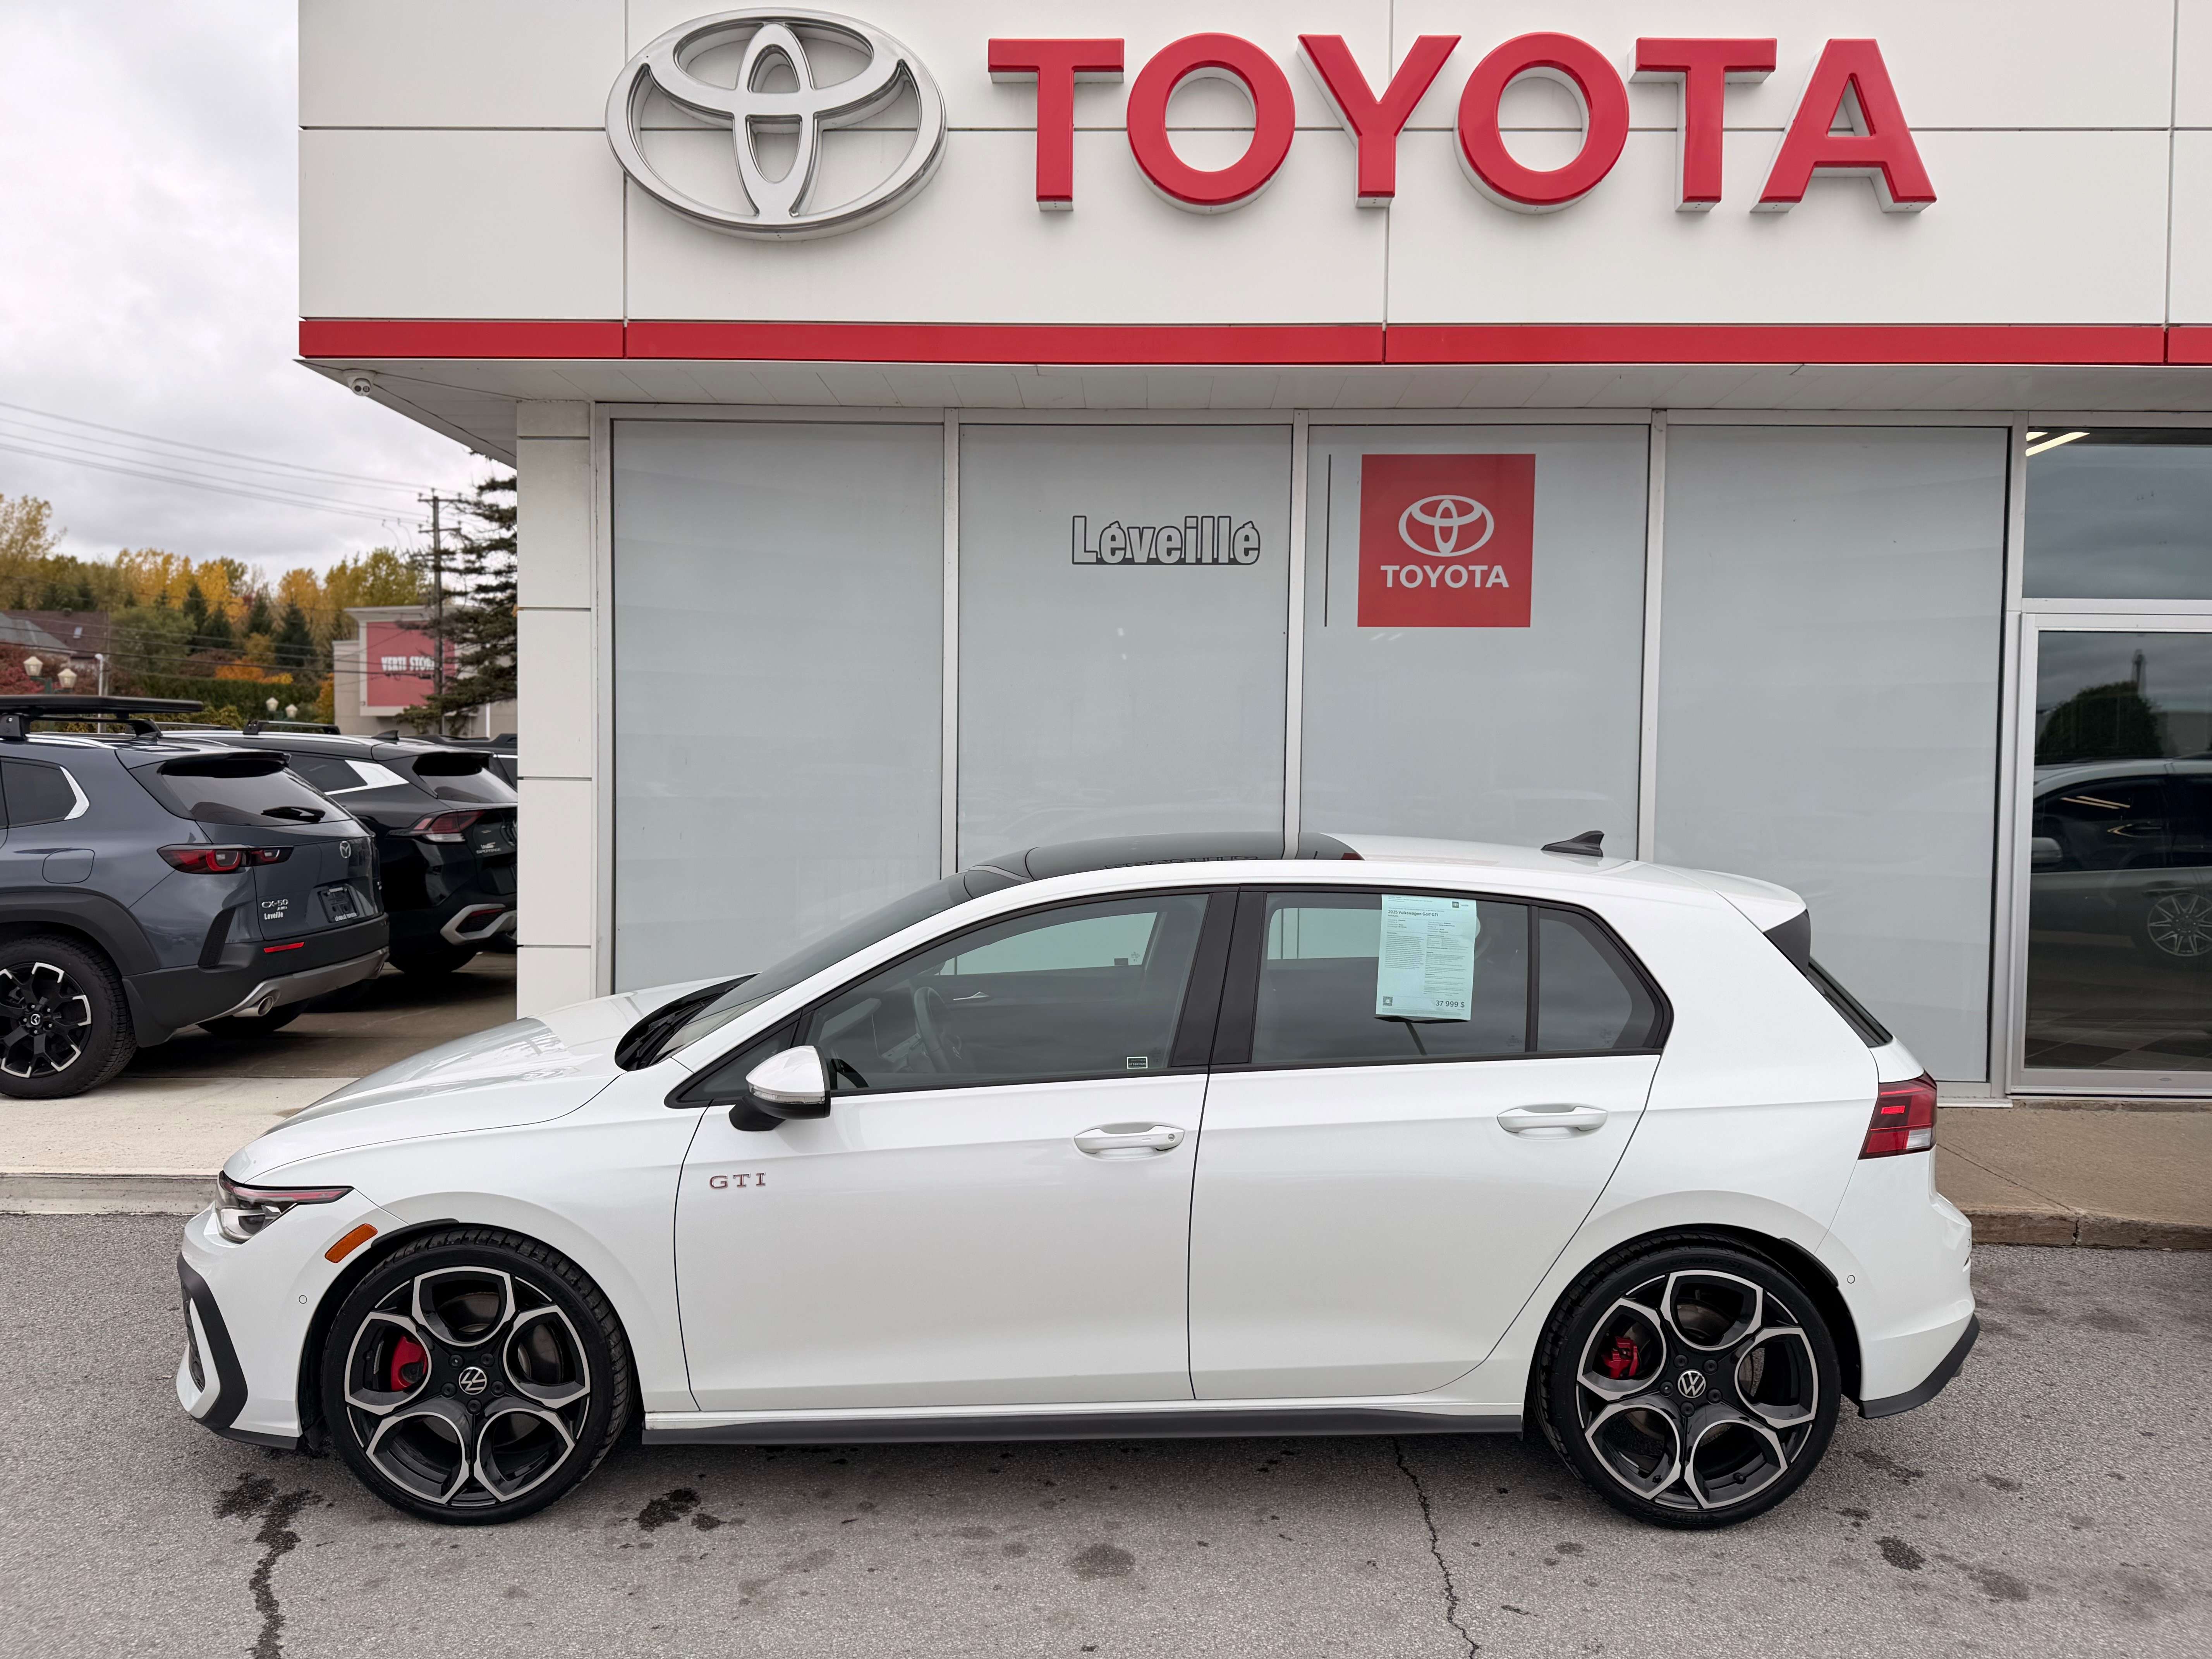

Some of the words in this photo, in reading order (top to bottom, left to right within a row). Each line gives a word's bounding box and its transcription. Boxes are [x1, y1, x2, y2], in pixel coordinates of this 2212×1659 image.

[988, 32, 1937, 211] TOYOTA
[1072, 516, 1260, 565] Léveillé
[1381, 565, 1509, 588] TOYOTA
[381, 656, 406, 671] VERTI
[261, 899, 288, 908] CX-50
[709, 1172, 766, 1190] GTI
[1678, 1370, 1706, 1398] VW
